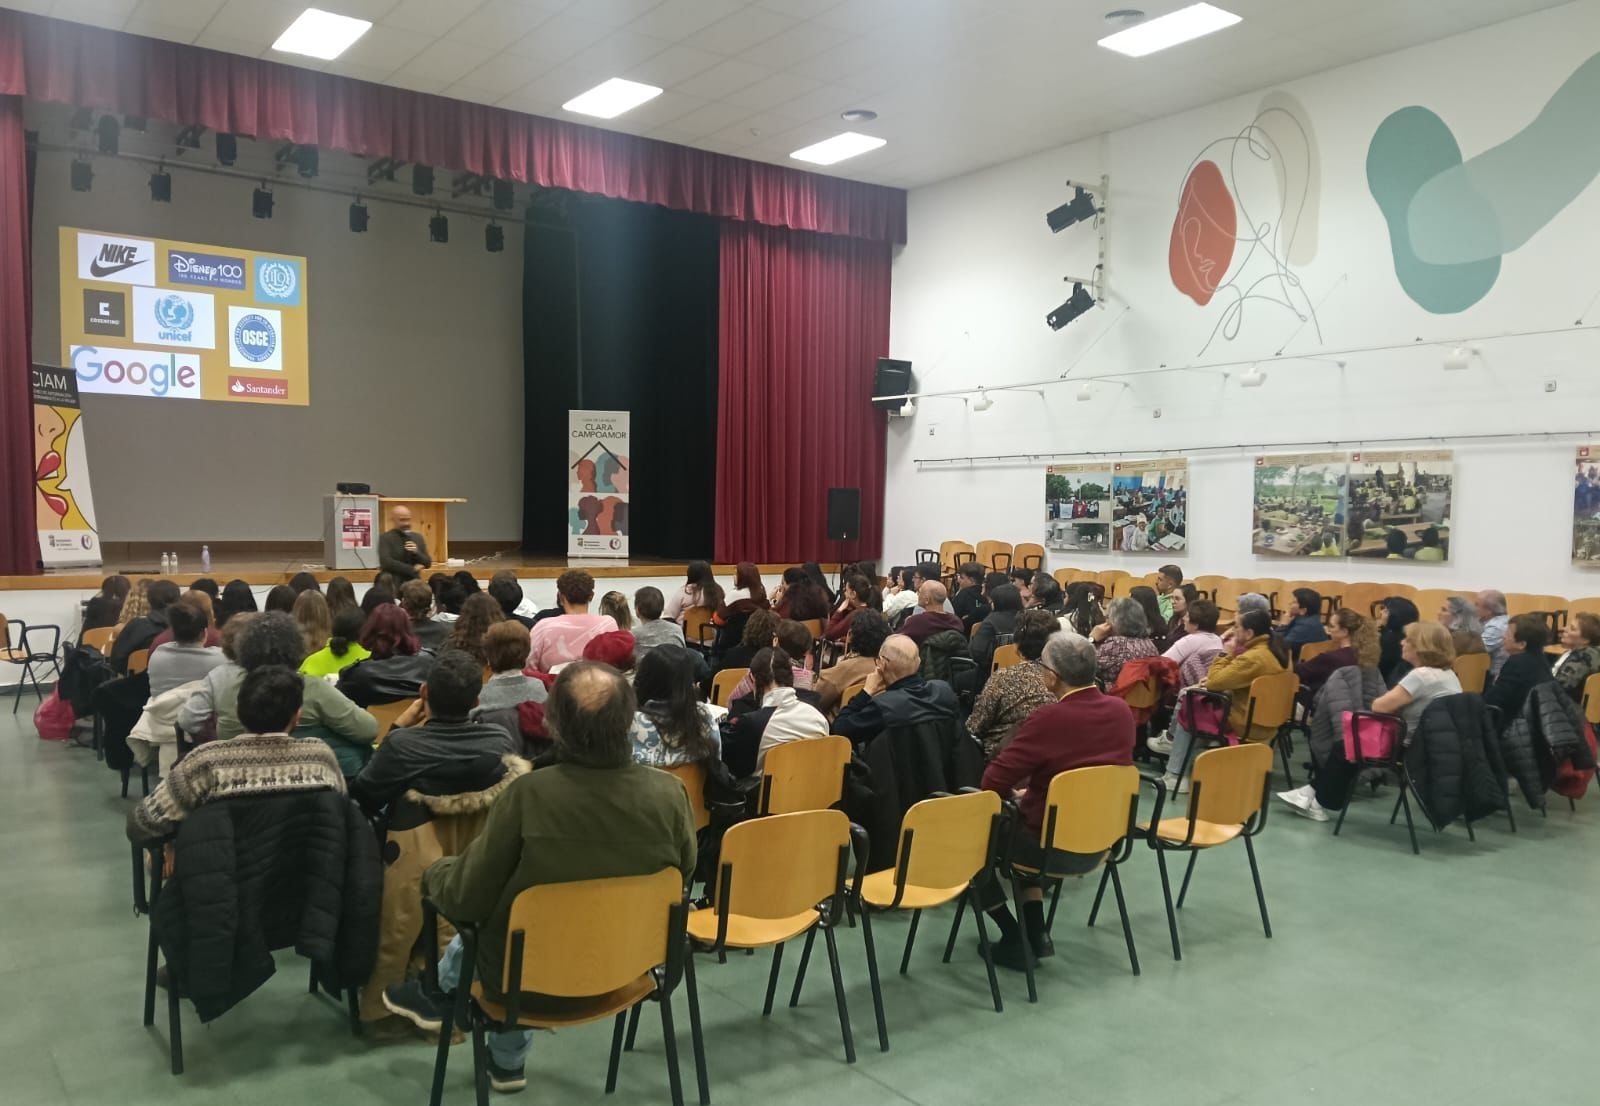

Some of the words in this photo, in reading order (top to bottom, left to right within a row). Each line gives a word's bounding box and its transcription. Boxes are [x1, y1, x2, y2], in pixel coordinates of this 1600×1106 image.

[98, 243, 137, 264] NIKE
[217, 264, 242, 279] 100
[158, 331, 192, 342] unicef
[242, 329, 269, 347] OSCE
[71, 346, 195, 396] Google
[246, 383, 286, 395] Santander
[585, 423, 613, 431] CLARA
[571, 430, 626, 439] CAMPOAMOR
